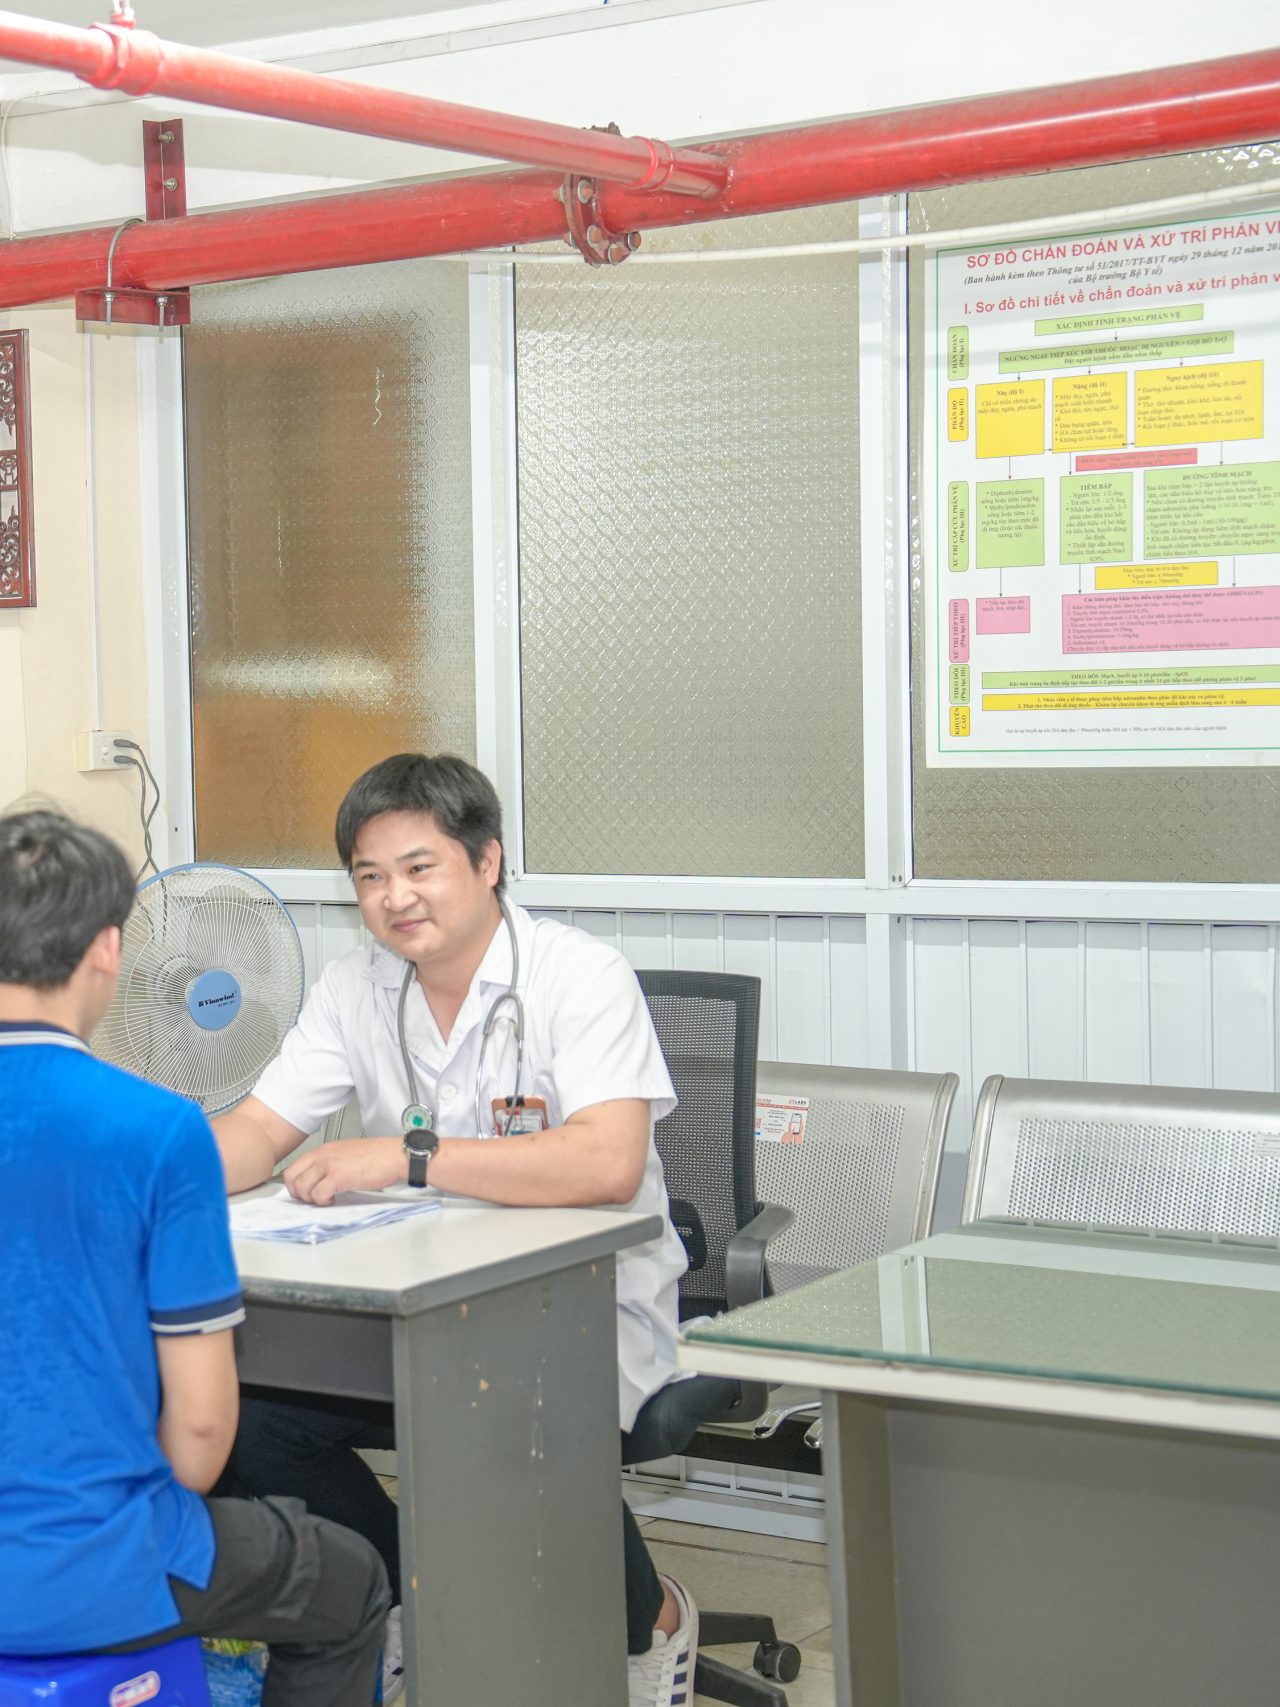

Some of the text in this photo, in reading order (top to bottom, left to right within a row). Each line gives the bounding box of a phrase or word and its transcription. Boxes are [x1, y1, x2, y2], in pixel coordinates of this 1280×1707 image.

[964, 276, 984, 286] (Ban
[1027, 270, 1044, 278] theo
[1191, 251, 1202, 260] 29
[1232, 246, 1243, 255] 12
[967, 254, 990, 268] SƠ
[994, 248, 1017, 266] ĐỒ
[1072, 238, 1118, 256] ĐOÁN
[1123, 233, 1145, 250] VÀ
[1150, 230, 1176, 248] XỬ
[1180, 226, 1206, 244] TRÍ
[1212, 222, 1260, 240] PHẢN
[964, 304, 972, 314] I.
[976, 301, 995, 314] Sơ
[998, 296, 1015, 311] đồ
[1020, 296, 1040, 308] chi
[1044, 290, 1066, 306] tiết
[1069, 288, 1085, 304] về
[1126, 282, 1162, 298] đoán
[1166, 280, 1183, 293] và
[1187, 278, 1207, 292] xử
[1210, 275, 1226, 289] trí
[1231, 272, 1268, 290] phản
